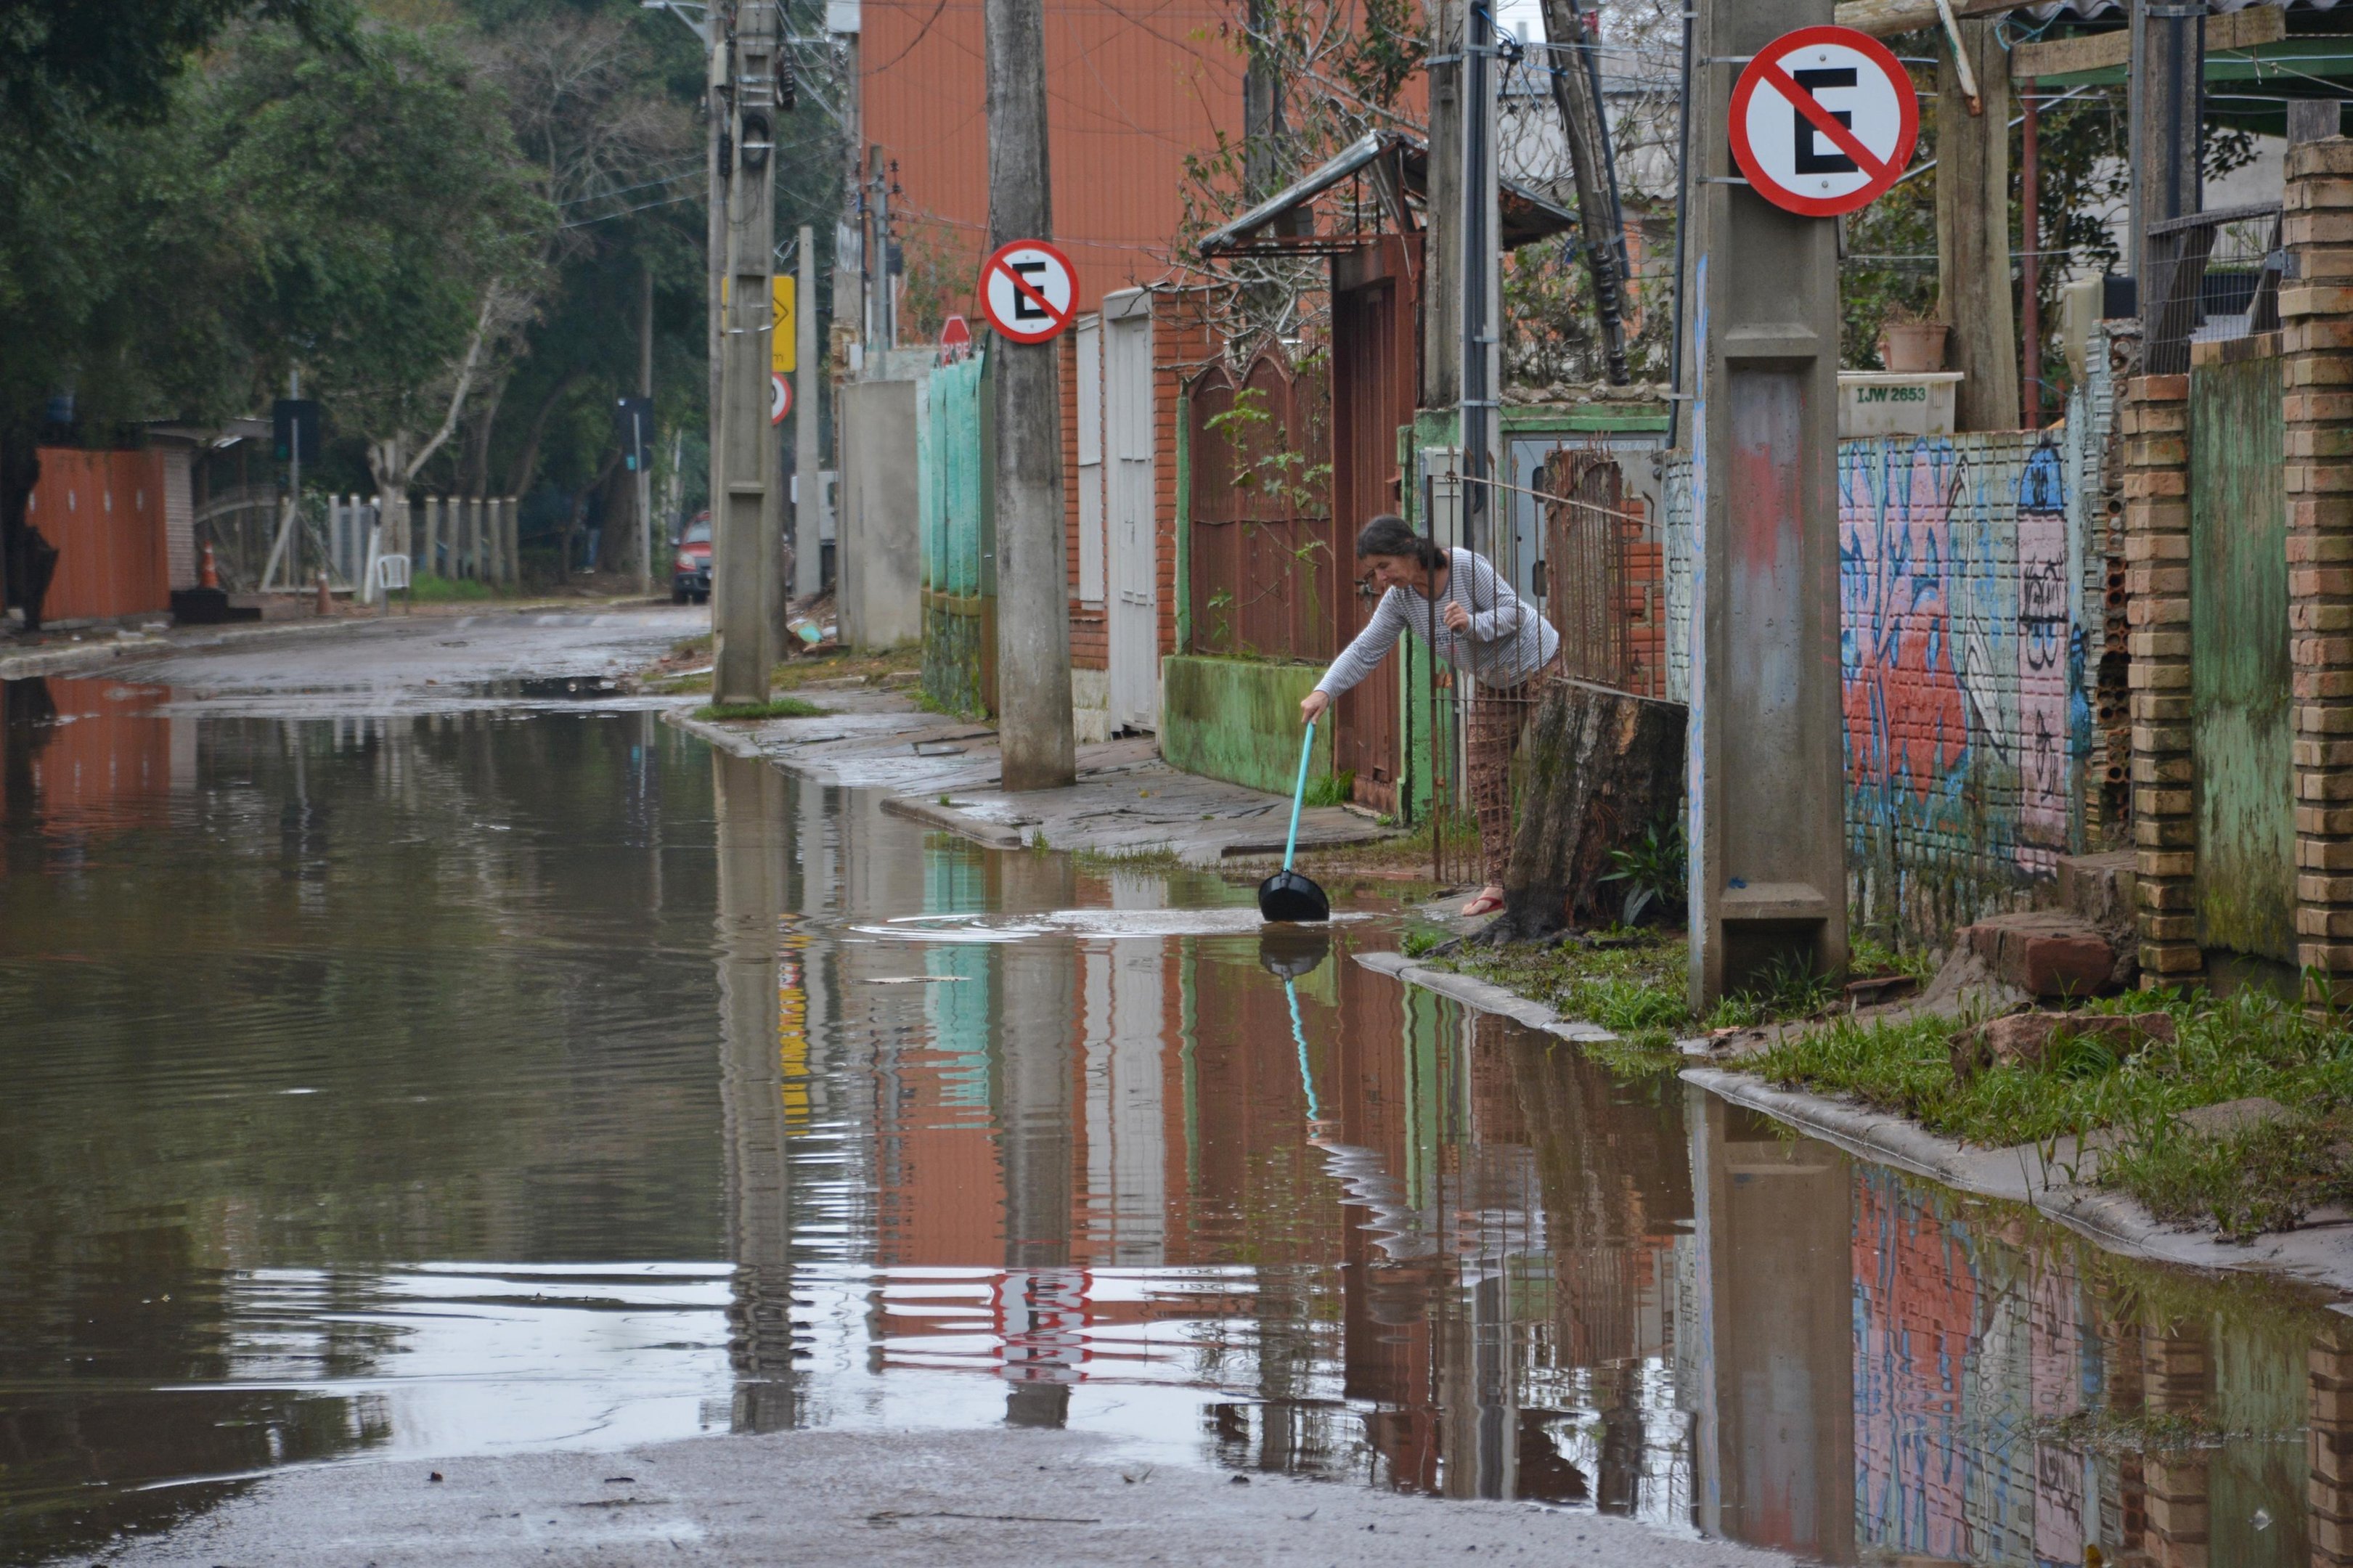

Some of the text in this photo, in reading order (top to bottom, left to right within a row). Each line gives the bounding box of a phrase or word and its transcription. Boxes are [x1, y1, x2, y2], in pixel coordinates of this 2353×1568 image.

[1793, 68, 1859, 174] E
[1012, 262, 1048, 320] E
[1857, 387, 1926, 403] IJW 2653
